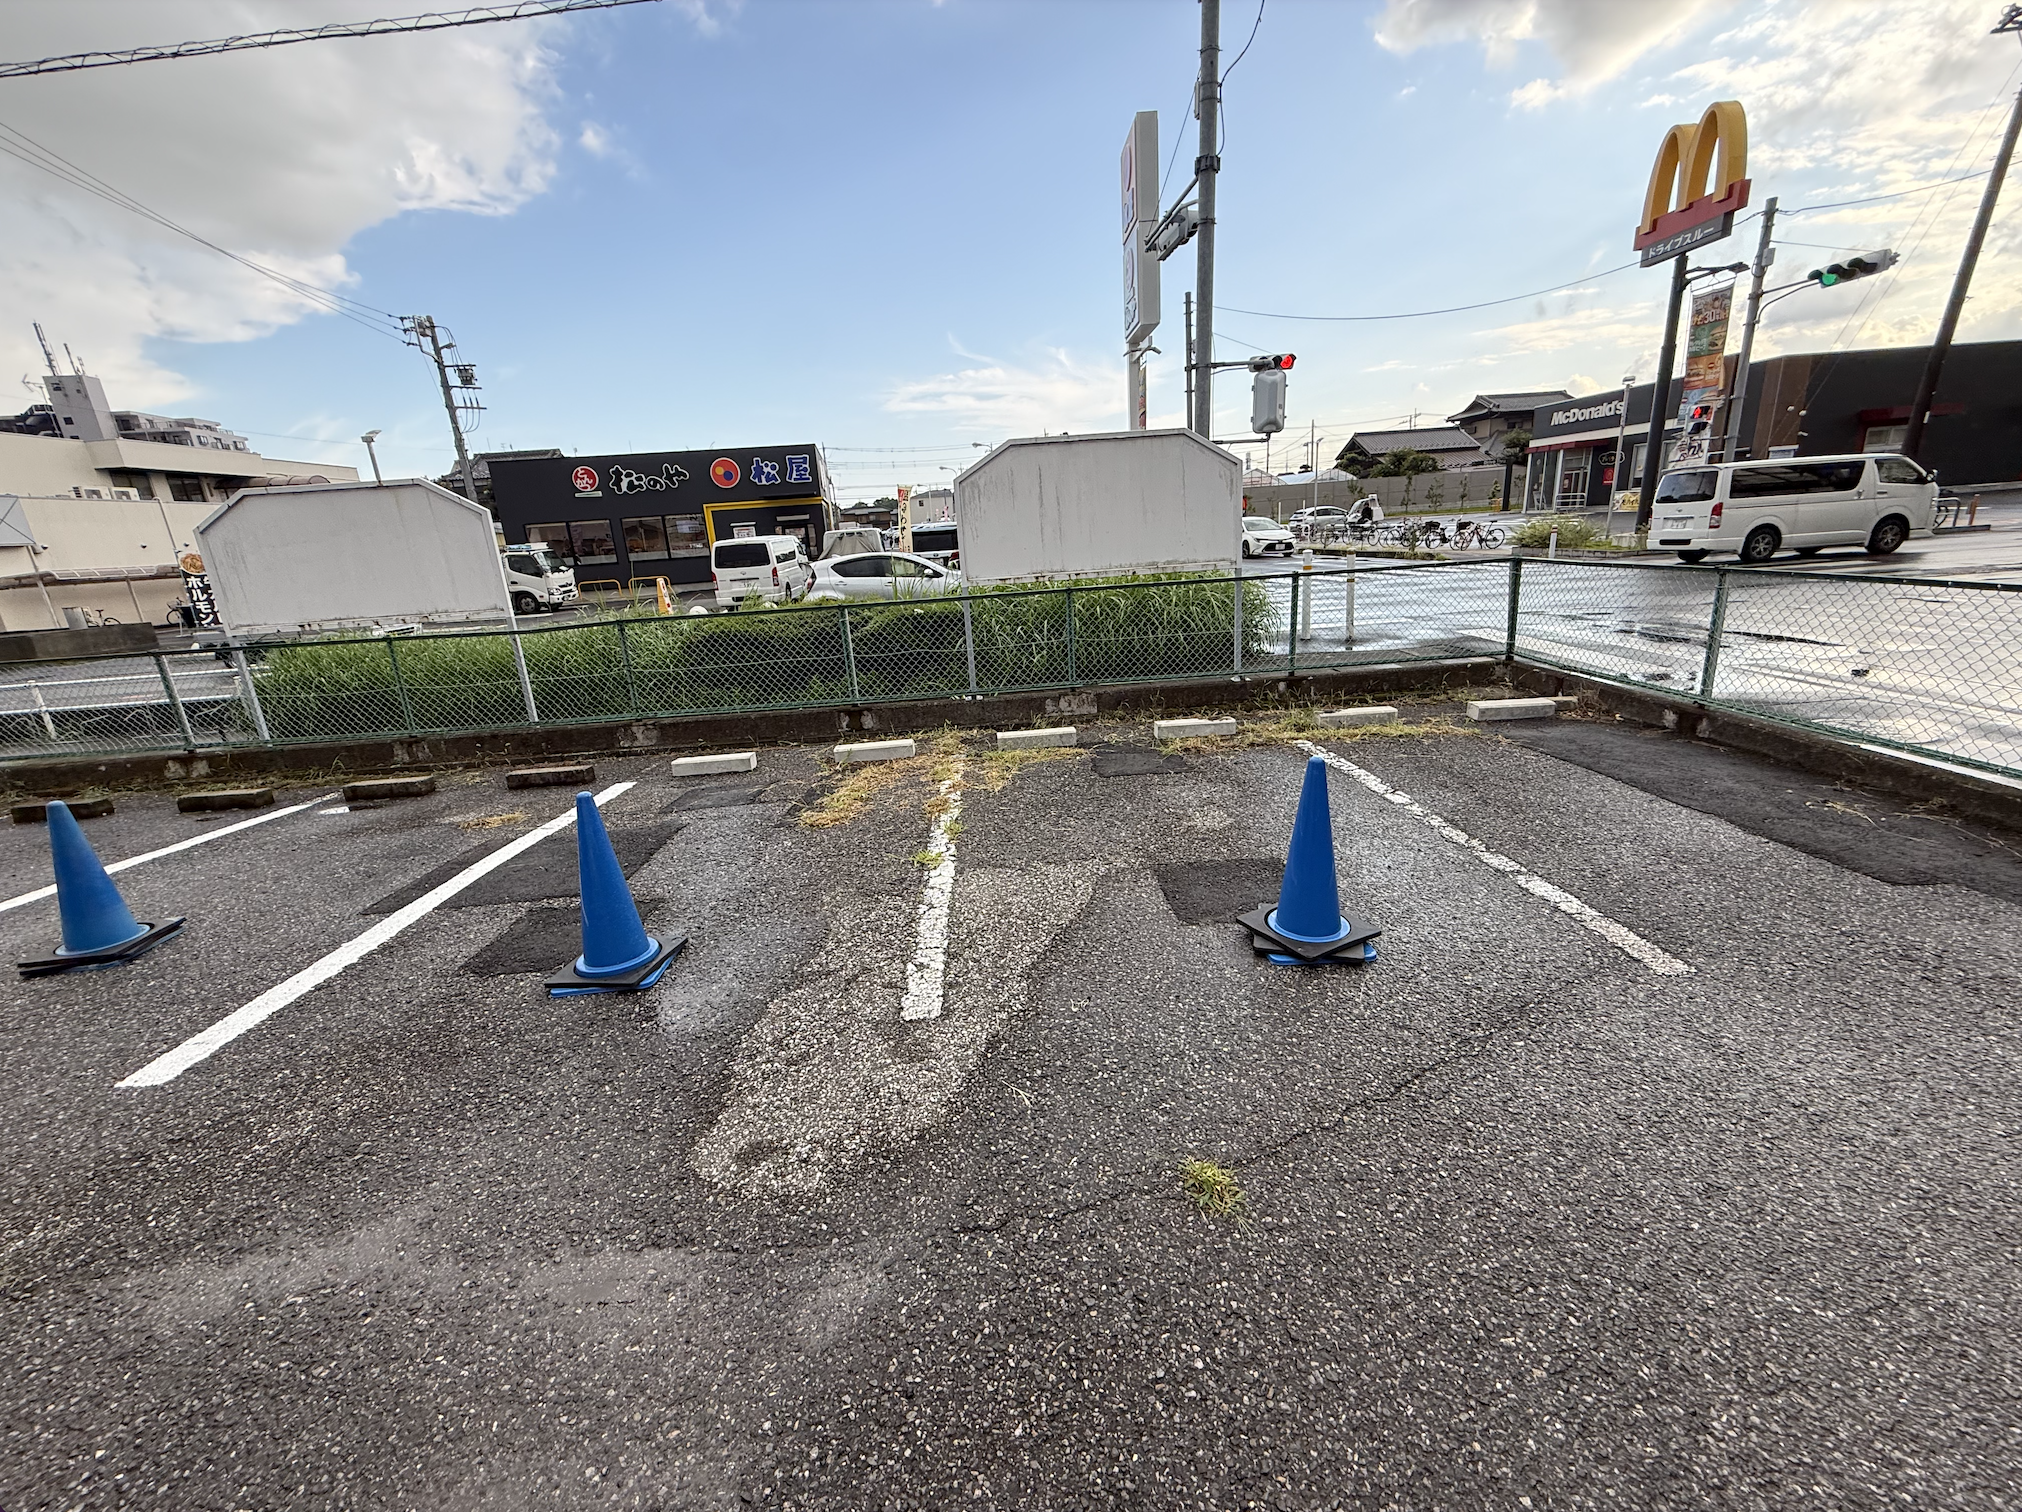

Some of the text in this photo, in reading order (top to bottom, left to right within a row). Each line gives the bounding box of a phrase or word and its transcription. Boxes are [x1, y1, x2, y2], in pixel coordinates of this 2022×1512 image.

[1648, 227, 1714, 258] ドライブスルー
[1550, 400, 1625, 426] McDonald's
[609, 463, 690, 495] 松のや
[749, 454, 813, 485] 松屋
[186, 576, 214, 625] ホルモン
